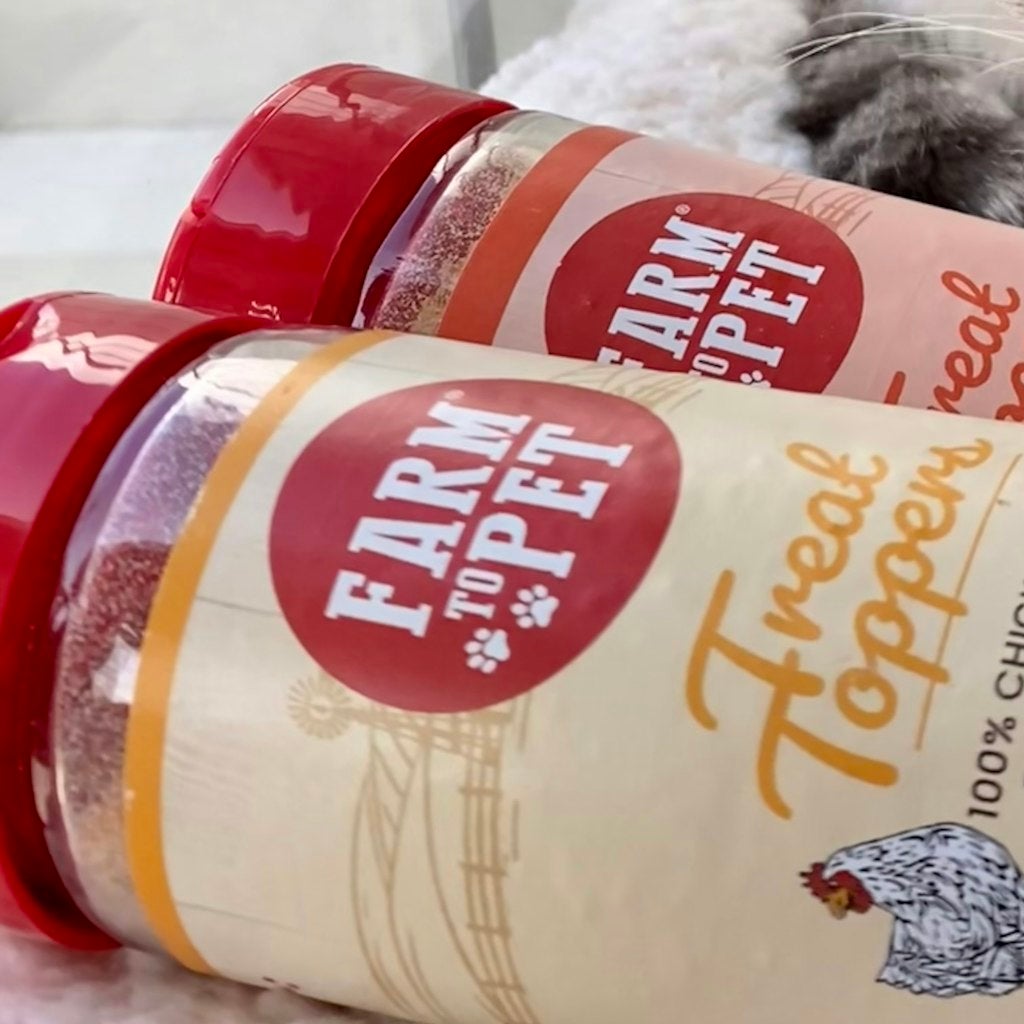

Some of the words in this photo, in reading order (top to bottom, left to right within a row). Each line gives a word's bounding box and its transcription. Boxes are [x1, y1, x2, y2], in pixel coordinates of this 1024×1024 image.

[689, 352, 730, 375] O
[699, 239, 826, 368] PET
[883, 270, 1021, 414] reat
[324, 401, 533, 638] FARM
[464, 422, 633, 579] PET
[444, 567, 505, 621] TO
[683, 441, 889, 732] Treat
[756, 437, 994, 822] Toppers
[966, 717, 1018, 819] 100%
